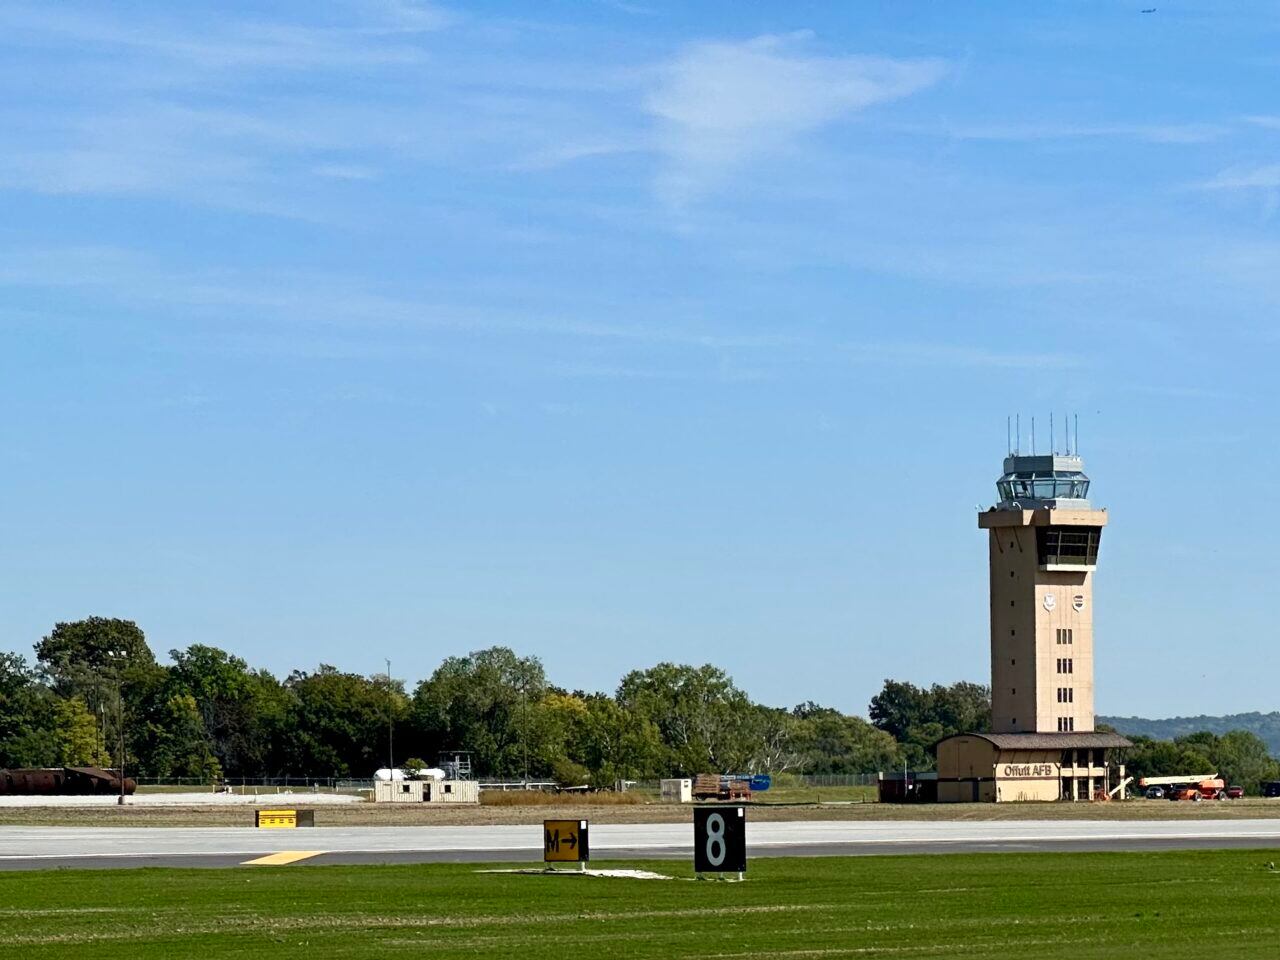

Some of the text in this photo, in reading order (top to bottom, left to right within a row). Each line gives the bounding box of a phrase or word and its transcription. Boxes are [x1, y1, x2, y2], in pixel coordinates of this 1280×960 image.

[1004, 764, 1052, 776] Offutt AFB
[546, 829, 559, 853] M
[706, 812, 726, 867] 8
